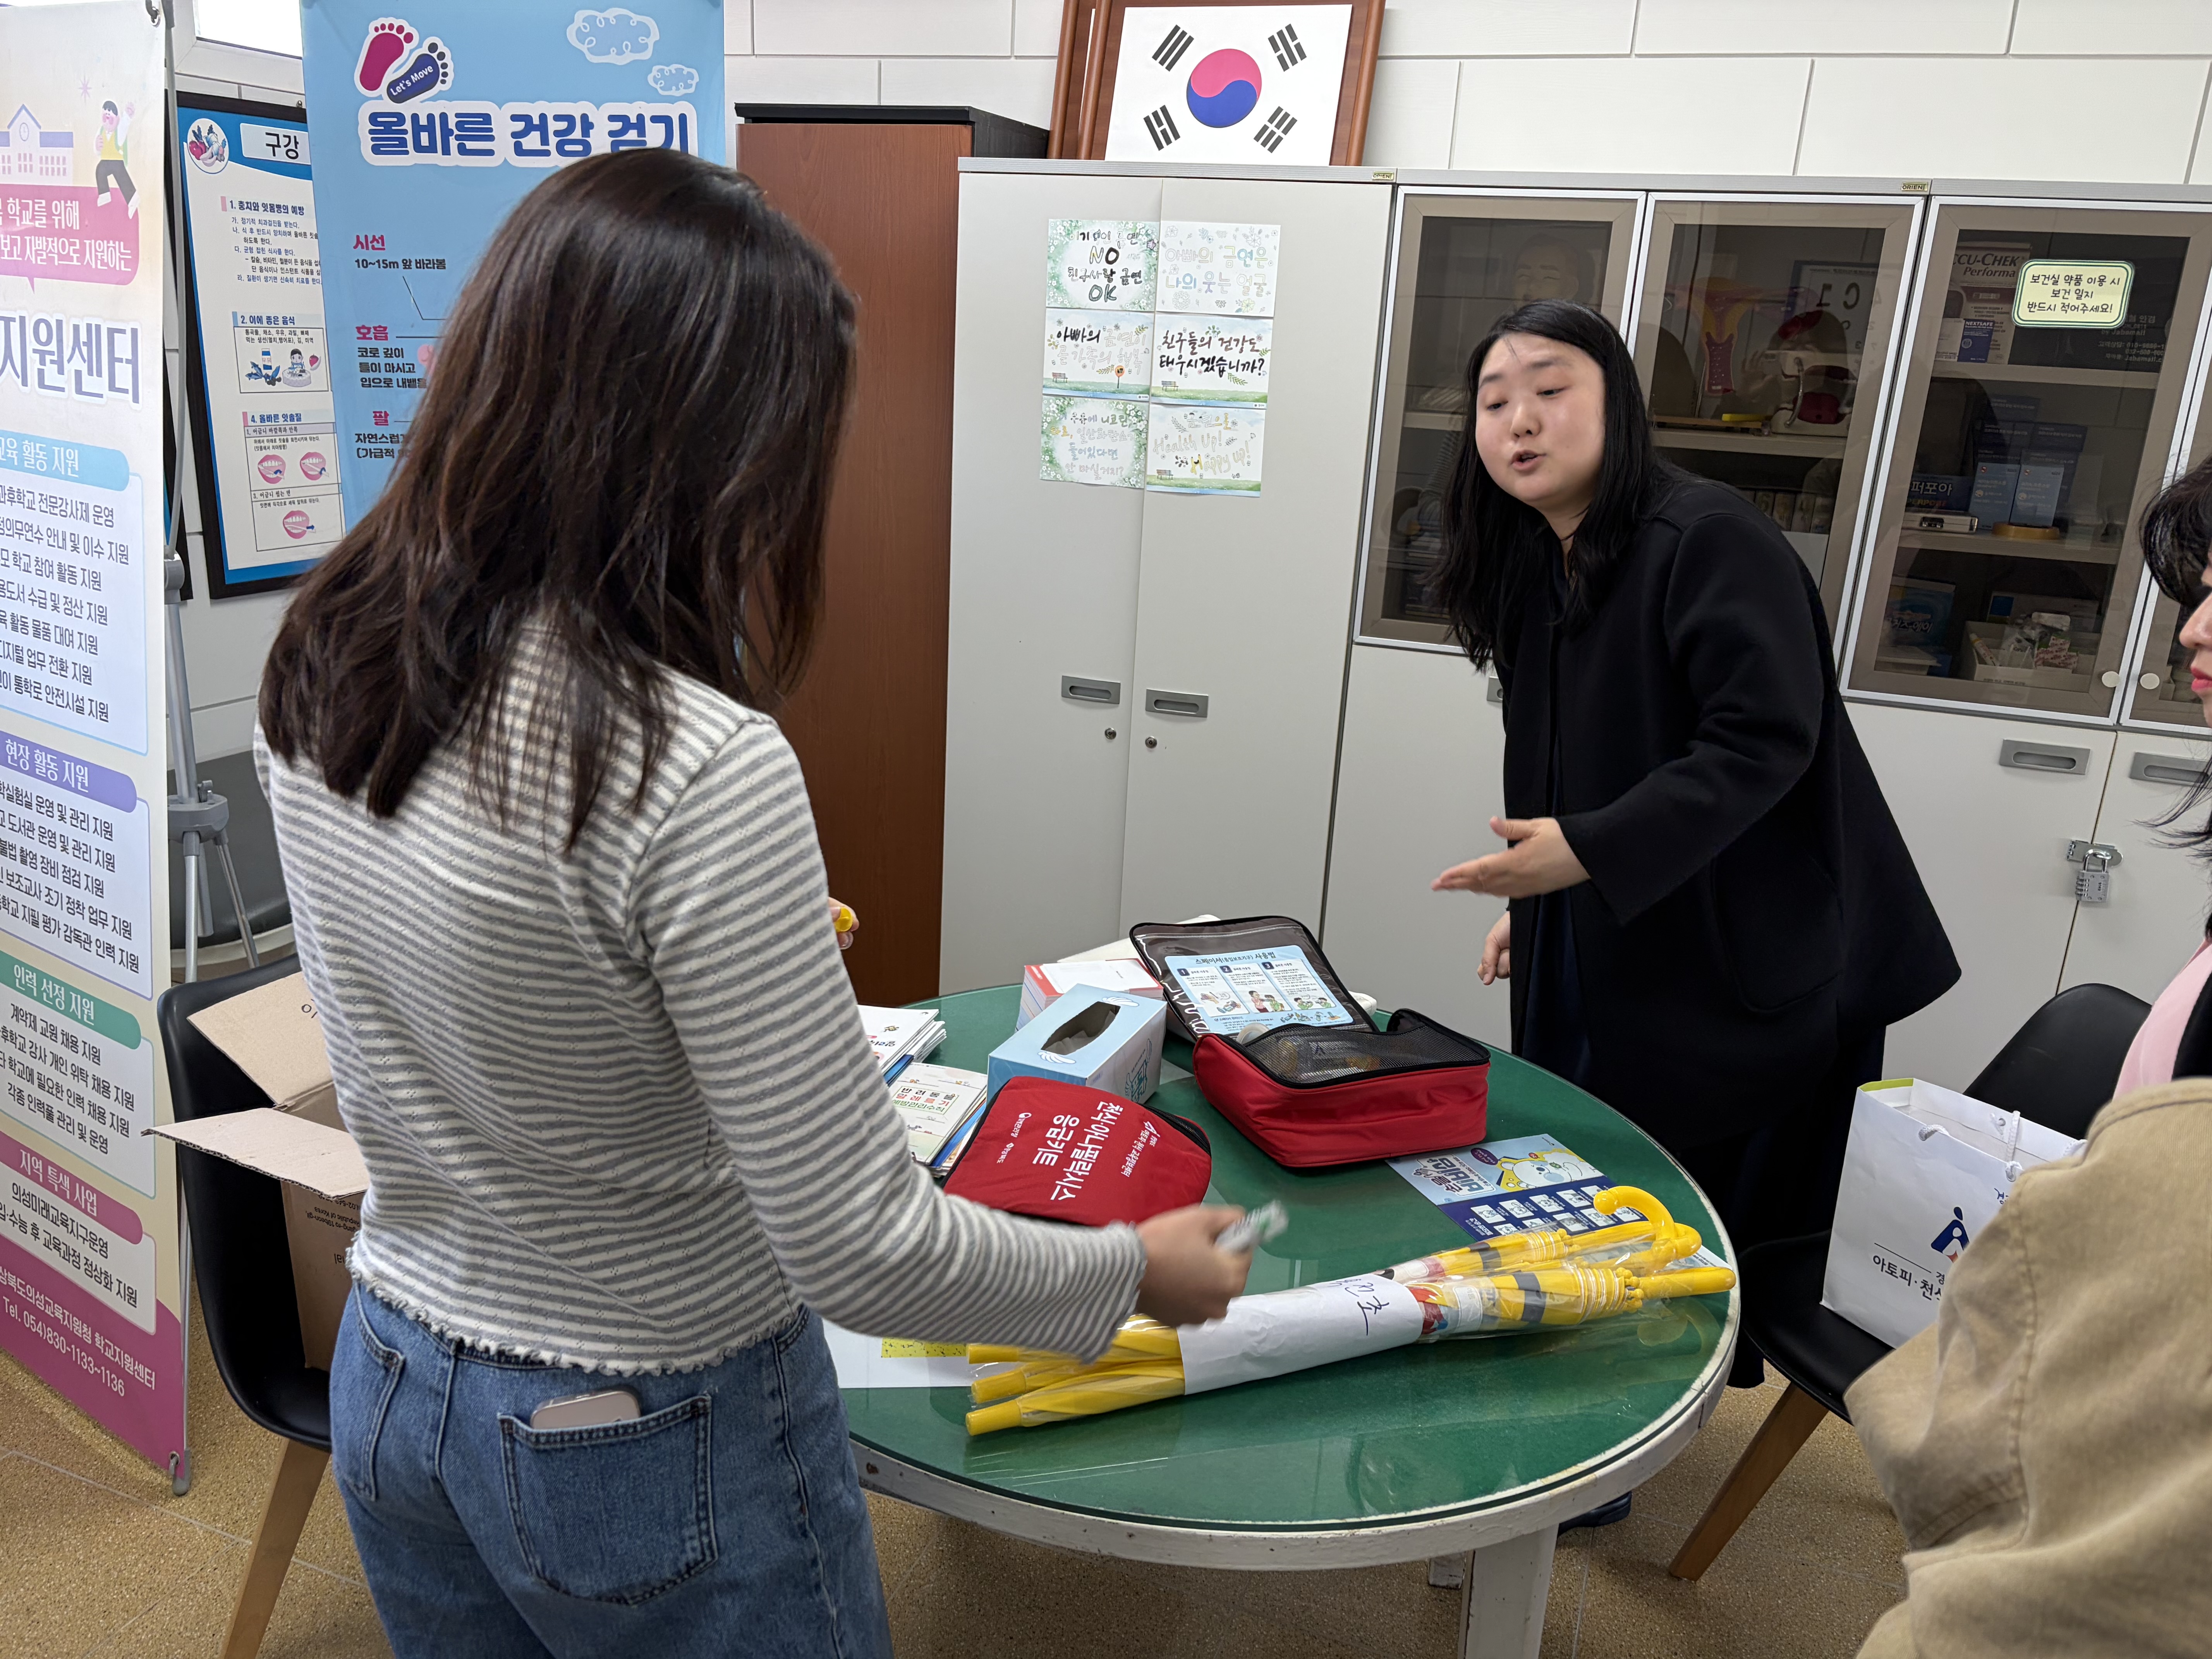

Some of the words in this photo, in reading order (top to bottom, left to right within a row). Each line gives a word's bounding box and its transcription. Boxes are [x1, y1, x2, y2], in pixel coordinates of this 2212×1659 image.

[390, 80, 412, 96] Let's
[410, 65, 433, 83] Move
[265, 131, 300, 159] 구강
[368, 111, 495, 156] 올바른
[510, 112, 594, 157] 건강
[607, 112, 688, 154] 걷기
[7, 197, 47, 228] 학교를
[52, 200, 80, 230] 위해
[230, 200, 236, 209] 1.
[238, 201, 259, 212] 충치와
[262, 202, 289, 214] 잇몸병의
[291, 205, 304, 216] 예방
[241, 217, 256, 225] 정기적
[258, 218, 282, 227] 치과검진을
[0, 234, 22, 261] 보고
[24, 235, 81, 266] 자발적으로
[84, 240, 132, 272] 지원하는
[353, 234, 386, 251] 시선
[355, 258, 399, 269] 10~15m
[401, 258, 412, 270] 앞
[415, 258, 447, 270] 바라봄
[1090, 246, 1120, 264] NO
[1165, 247, 1213, 263] 아빠의
[1223, 246, 1268, 268] 금연은
[1068, 267, 1116, 283] 친구사랑
[1120, 268, 1142, 285] 금연
[1166, 273, 1197, 290] 나의
[1203, 271, 1231, 294] 웃는
[1237, 273, 1267, 297] 얼굴
[1963, 266, 2016, 278] Performa
[2030, 273, 2060, 286] 보건실
[2063, 274, 2083, 287] 약품
[2087, 275, 2107, 287] 이용
[2109, 276, 2120, 286] 시
[1089, 284, 1117, 302] OK
[2051, 288, 2071, 300] 보건
[2074, 288, 2094, 300] 일지
[2027, 301, 2057, 313] 반드시
[2060, 301, 2113, 314] 적어주세요!
[240, 315, 247, 324] 2.
[249, 315, 263, 325] 이에
[266, 316, 279, 325] 좋은
[282, 316, 295, 325] 음식
[355, 325, 388, 341] 호흡
[1057, 326, 1101, 343] 아빠의
[1162, 330, 1212, 356] 친구들의
[1218, 335, 1260, 354] 건강도
[0, 314, 139, 404] 지원센터
[357, 347, 380, 358] 코로
[383, 347, 404, 358] 깊이
[359, 362, 381, 373] 들이
[384, 362, 416, 373] 마시고
[1159, 354, 1265, 378] 태우시겠습니까?
[360, 377, 394, 388] 입으로
[251, 415, 257, 423] 4.
[259, 414, 280, 423] 올바른
[282, 413, 302, 422] 잇솔질
[373, 410, 389, 426] 팔
[1069, 442, 1118, 460] 들어있다면
[1153, 434, 1197, 454] Health
[1201, 430, 1222, 452] Up!
[1065, 462, 1076, 474] 안
[1190, 454, 1231, 475] Happy
[38, 493, 89, 523] 전문강사제
[93, 504, 114, 528] 운영
[46, 527, 67, 551] 안내
[69, 532, 81, 554] 및
[83, 536, 105, 559] 이수
[107, 541, 129, 565] 지원
[14, 674, 43, 701] 통학로
[45, 684, 85, 716] 안전시설
[88, 698, 109, 723] 지원
[5, 739, 30, 771] 현장
[34, 749, 58, 781] 활동
[62, 759, 89, 793] 지원
[6, 869, 42, 902] 보조교사
[45, 885, 63, 911] 조기
[66, 895, 85, 921] 정착
[88, 905, 109, 930] 업무
[112, 915, 132, 941] 지원
[1255, 951, 1277, 961] 사용법
[14, 964, 38, 998] 인력
[41, 978, 65, 1011] 선정
[70, 991, 94, 1026] 지원
[10, 1003, 37, 1033] 계약제
[40, 1018, 58, 1044] 교원
[61, 1029, 79, 1054] 채용
[81, 1039, 101, 1066] 지원
[29, 1040, 47, 1065] 강사
[50, 1051, 68, 1077] 개인
[70, 1062, 89, 1088] 위탁
[91, 1073, 111, 1100] 채용
[114, 1085, 135, 1112] 지원
[8, 1082, 25, 1107] 각종
[27, 1094, 55, 1124] 인력풀
[57, 1109, 75, 1136] 관리
[77, 1121, 87, 1144] 및
[89, 1130, 108, 1155] 운영
[1032, 1114, 1080, 1166] 응급키트
[1050, 1101, 1124, 1200] 천식·아나필락시스
[20, 1149, 43, 1183] 지역
[47, 1164, 70, 1199] 특색
[74, 1182, 97, 1217] 사업
[12, 1182, 109, 1260] 의성미래교육지구운영
[314, 1207, 330, 1217] Korea
[30, 1221, 40, 1242] 후
[43, 1229, 81, 1270] 교육과정
[84, 1256, 113, 1293] 정상화
[116, 1278, 137, 1309] 지원
[3, 1296, 21, 1323] Tel.
[24, 1310, 125, 1397] 054)830-1133~1136
[95, 1332, 155, 1391] 학교지원센터
